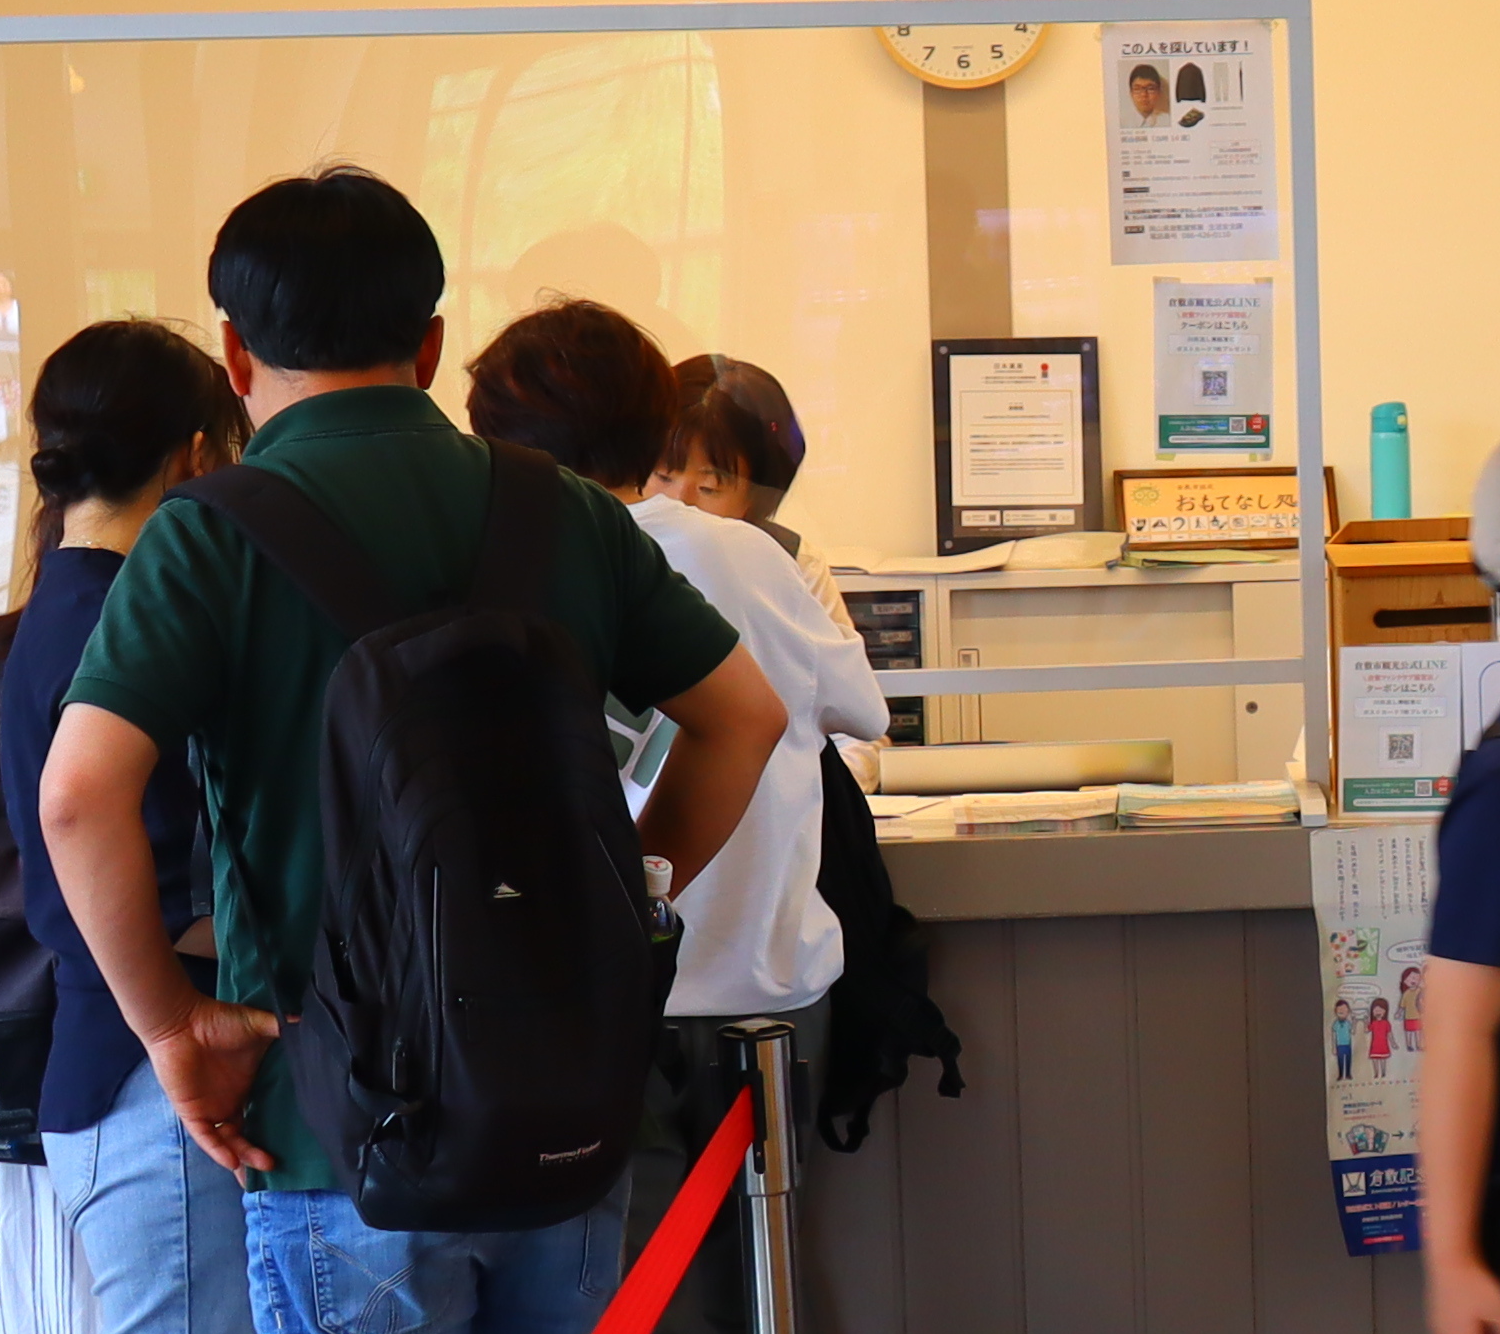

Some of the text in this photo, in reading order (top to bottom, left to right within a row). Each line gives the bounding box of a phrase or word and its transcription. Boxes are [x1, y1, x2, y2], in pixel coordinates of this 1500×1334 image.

[922, 46, 935, 61] 7
[991, 44, 1003, 59] 5
[1121, 40, 1250, 55] この人を探しています！
[957, 55, 970, 68] 6
[1175, 493, 1298, 513] おもてなし処
